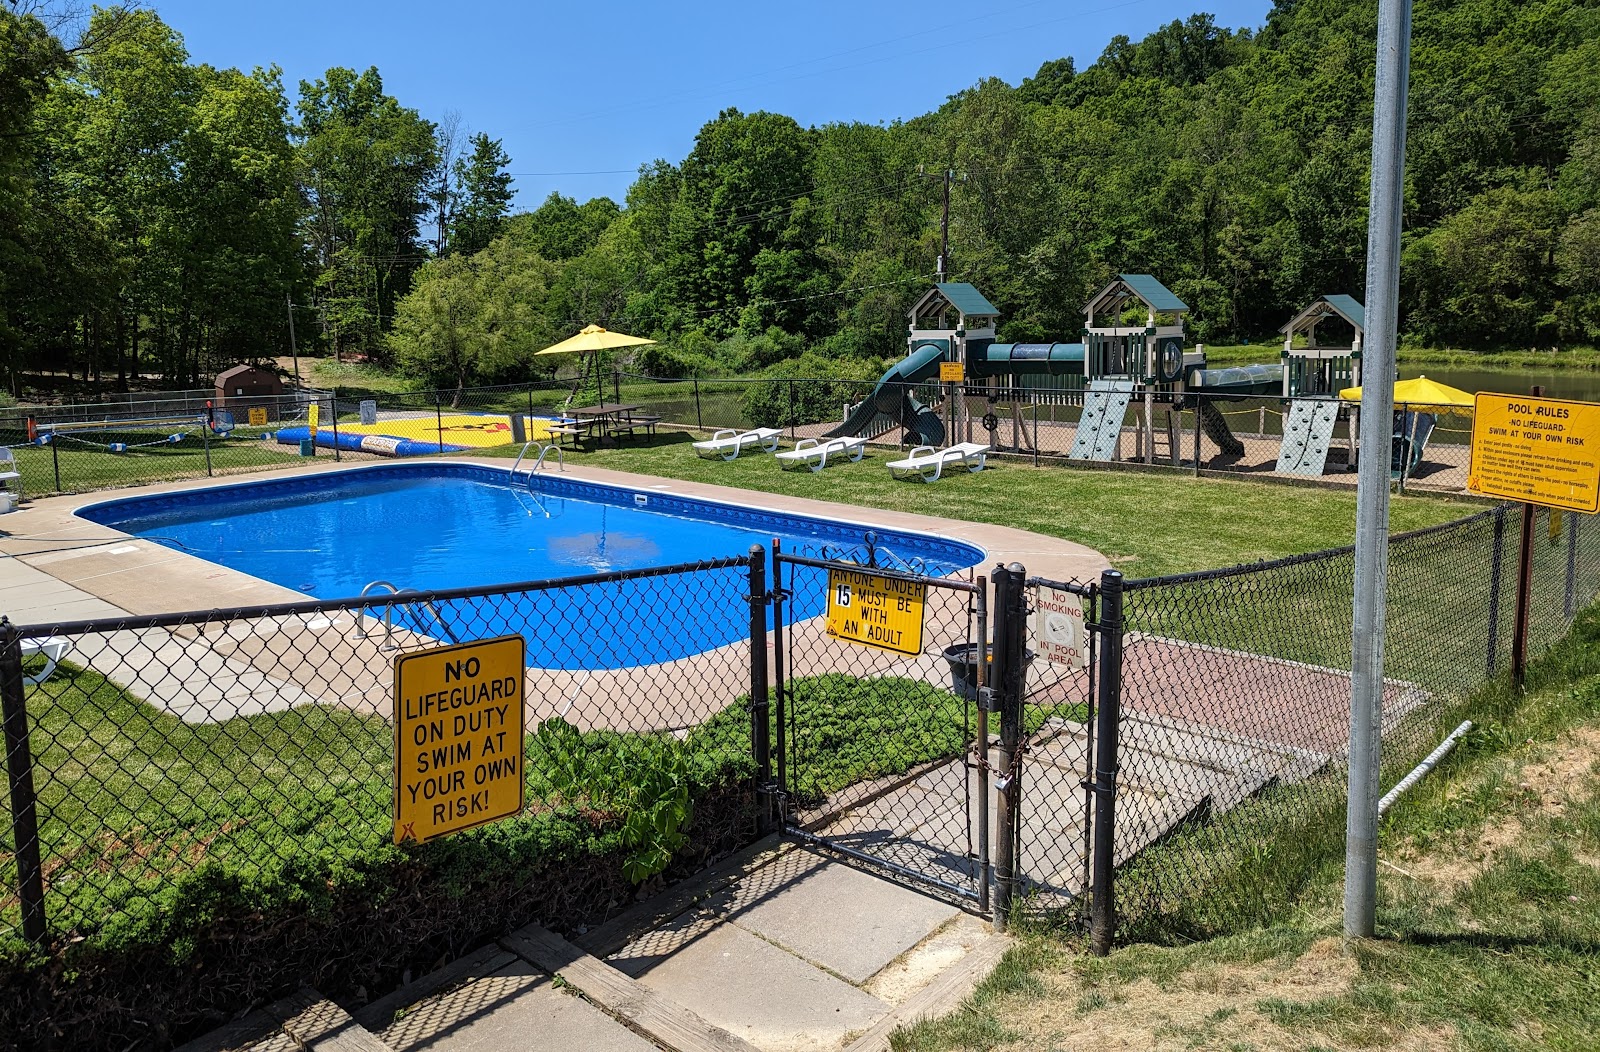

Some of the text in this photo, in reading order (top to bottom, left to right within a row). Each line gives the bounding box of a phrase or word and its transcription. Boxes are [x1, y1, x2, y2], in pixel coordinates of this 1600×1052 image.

[1508, 404, 1569, 418] POOL RULES
[1489, 427, 1584, 446] SWIM AT YOUR OWN RISK
[834, 571, 922, 597] ANYONE UNDER
[837, 584, 850, 606] 15
[858, 589, 888, 607] MUST
[898, 597, 912, 613] BE
[1038, 600, 1081, 617] SMOKING
[1052, 593, 1066, 602] NO
[861, 607, 888, 624] WITH
[844, 620, 902, 646] AN ADULT
[1041, 641, 1081, 658] IN POOL
[1048, 653, 1073, 666] AREA
[445, 657, 480, 683] NO
[406, 677, 516, 720] LIFEGUARD
[414, 704, 509, 746] ON DUTY
[417, 732, 506, 773] SWIM AT
[407, 756, 516, 804] YOUR OWN
[433, 790, 489, 826] RISK!
